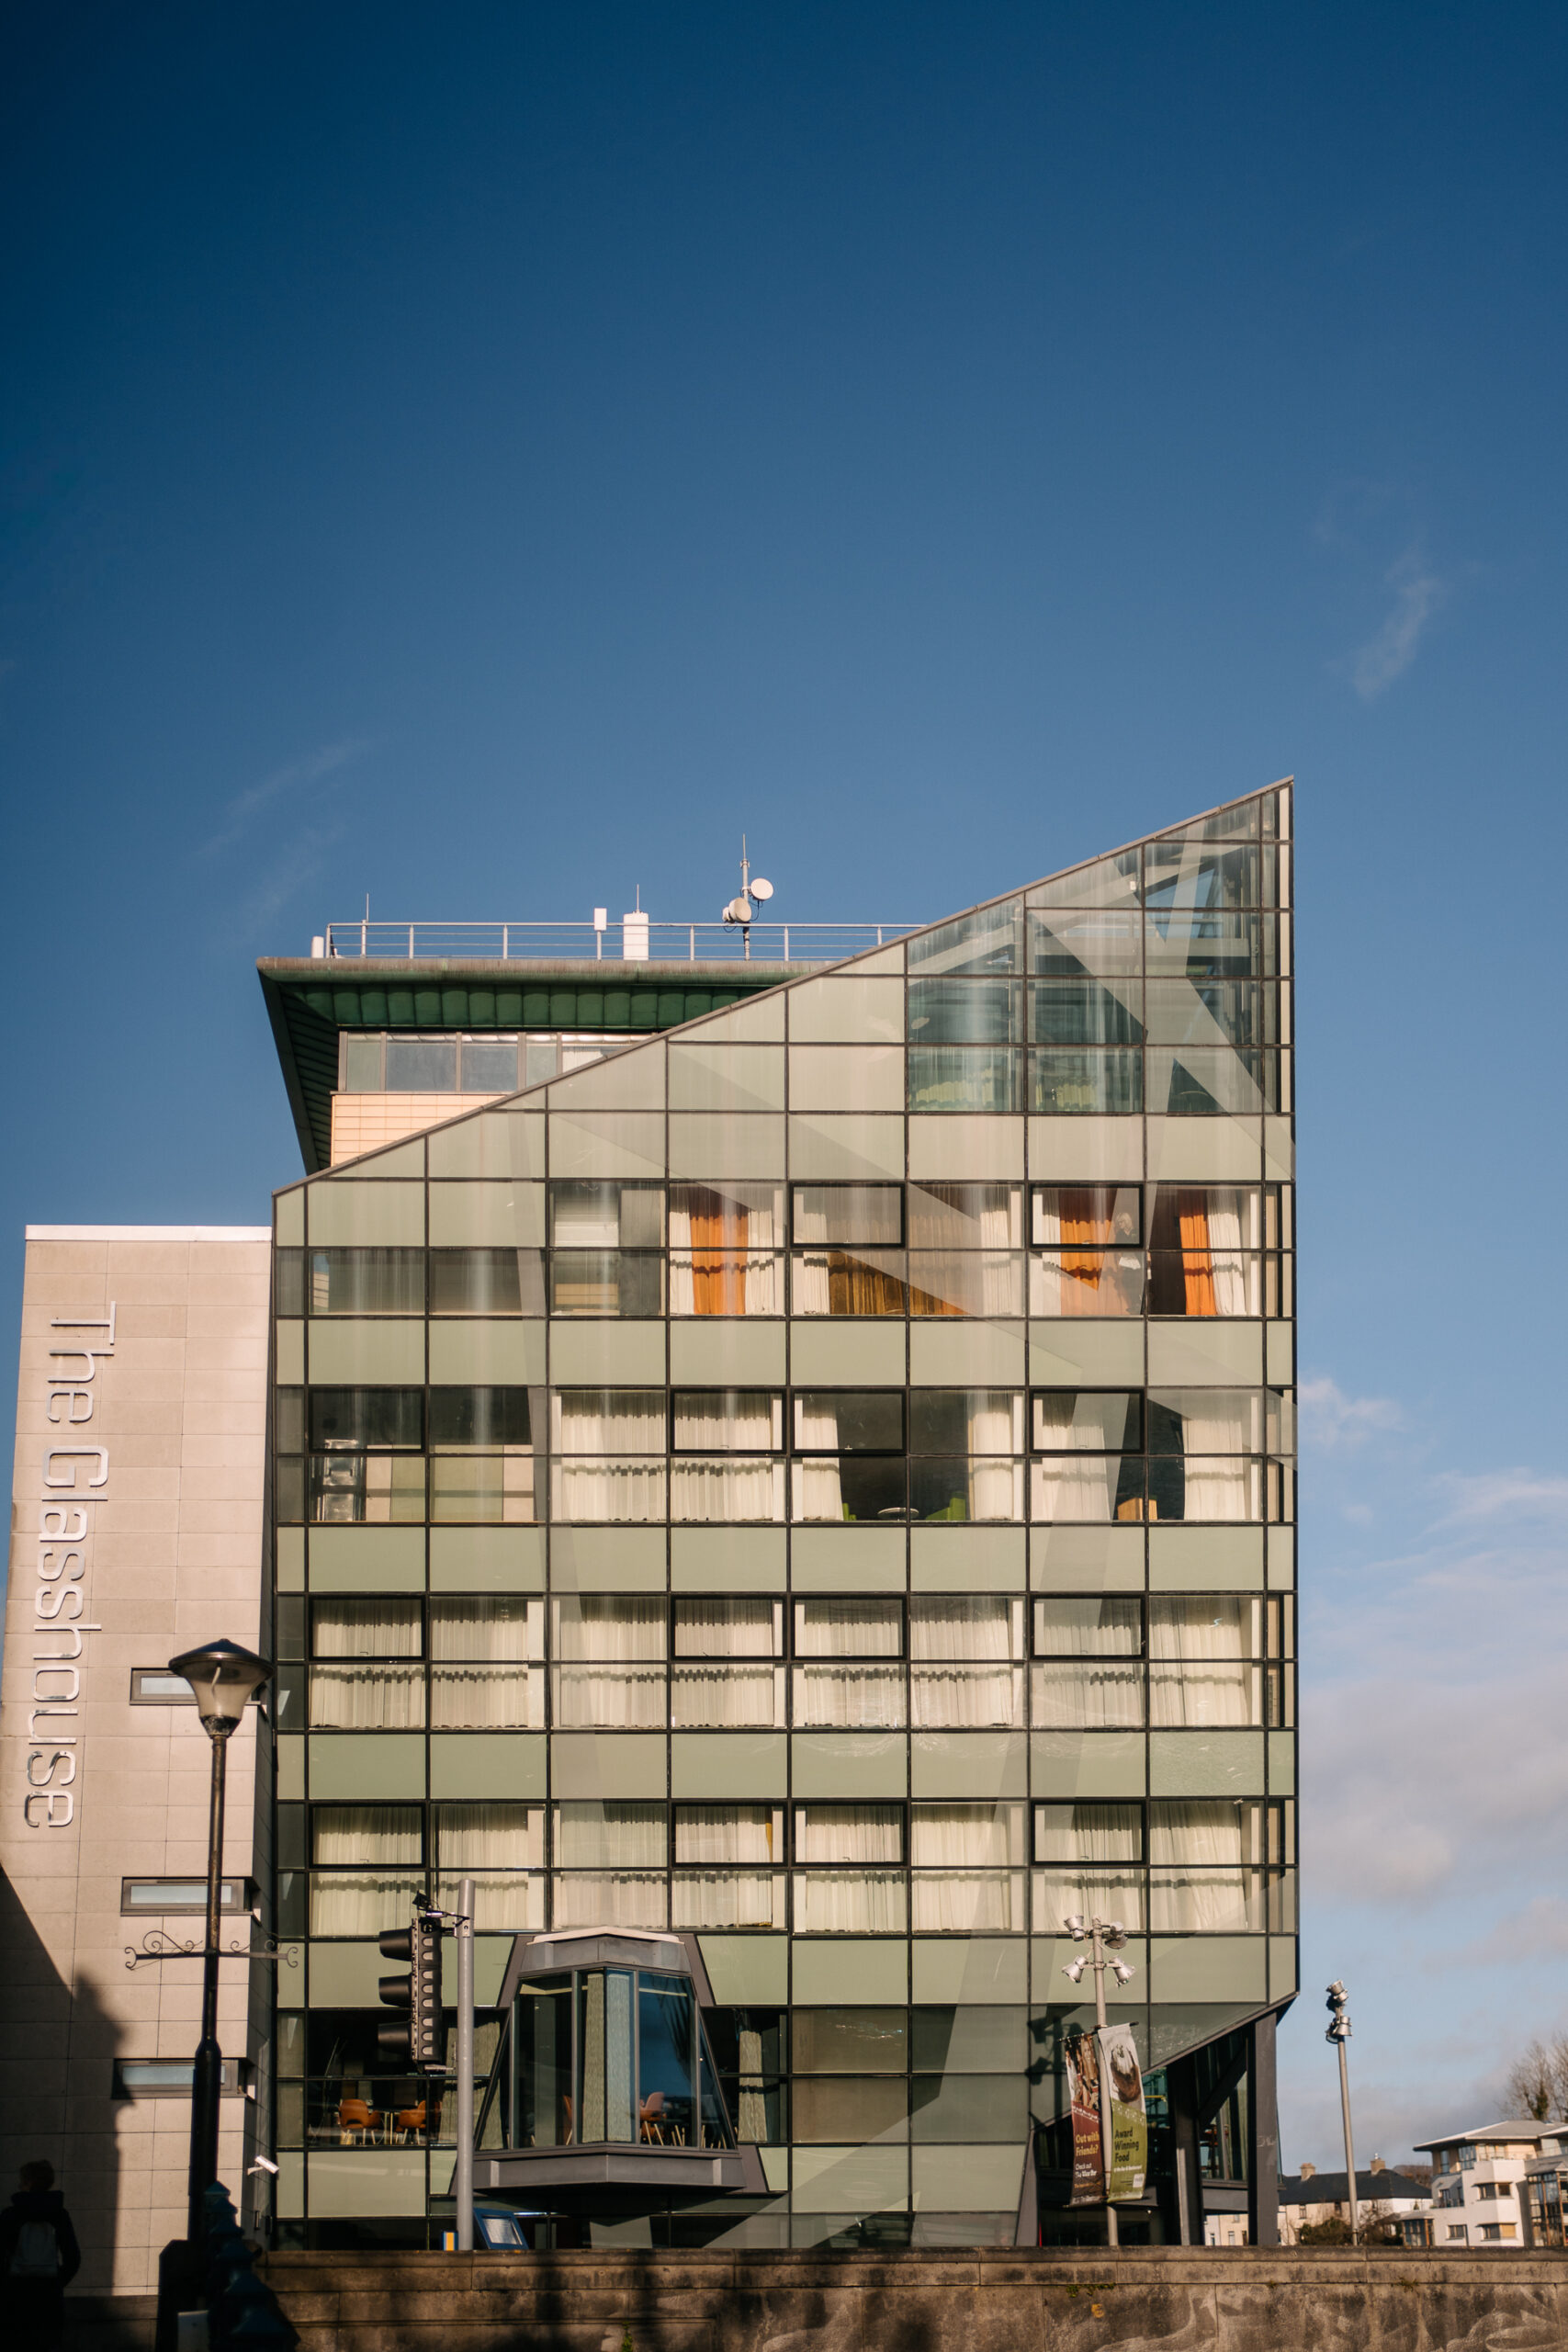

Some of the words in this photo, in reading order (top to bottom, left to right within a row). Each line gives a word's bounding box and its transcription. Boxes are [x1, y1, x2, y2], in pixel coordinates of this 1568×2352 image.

[47, 1300, 116, 1422] The
[24, 1445, 108, 1827] Glasshouse
[1076, 2134, 1087, 2143] Out
[1088, 2132, 1100, 2143] with
[1114, 2127, 1134, 2139] Award
[1076, 2144, 1099, 2156] Friends?
[1114, 2139, 1139, 2152] Winning
[1115, 2153, 1130, 2163] Food
